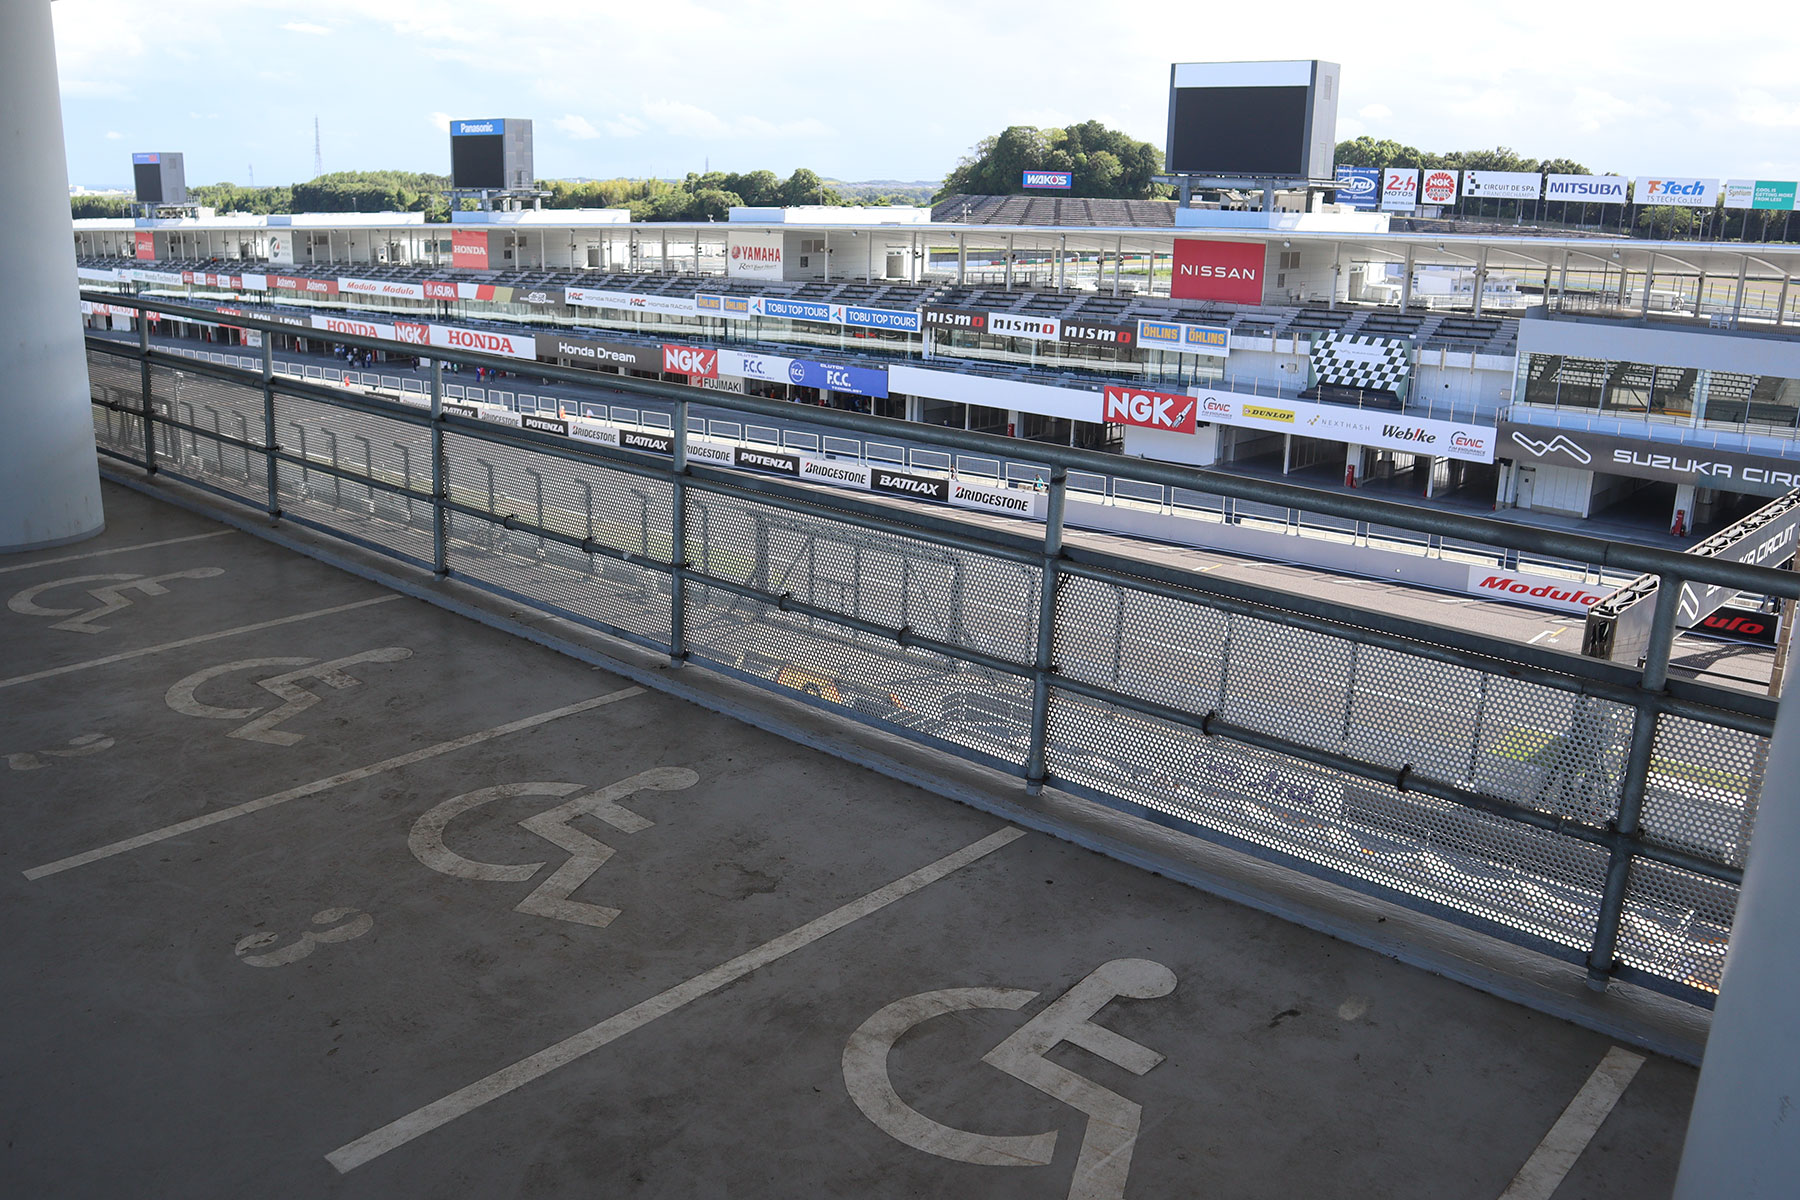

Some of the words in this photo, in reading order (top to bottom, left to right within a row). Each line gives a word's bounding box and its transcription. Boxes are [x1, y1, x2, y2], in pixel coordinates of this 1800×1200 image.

[461, 122, 494, 133] Panasonic
[1430, 179, 1450, 187] NGK
[1550, 182, 1622, 196] MITSUBA
[454, 246, 486, 255] HONDA
[742, 246, 781, 262] YAMAHA
[1181, 264, 1256, 280] NISSAN
[347, 282, 376, 292] Modulo
[382, 285, 414, 295] Modulo
[433, 286, 456, 298] ASURA
[568, 292, 582, 300] HRC
[630, 298, 646, 308] HRC
[768, 302, 787, 313] TOBU
[788, 305, 803, 315] TOP
[804, 307, 828, 318] TOURS
[849, 311, 870, 322] TOBU
[872, 314, 888, 324] TOP
[889, 316, 916, 327] TOURS
[326, 320, 378, 338] HONDA
[396, 324, 421, 344] NGK
[1143, 324, 1178, 340] ÖHLINS
[1188, 328, 1224, 344] ÖHLINS
[448, 330, 514, 353] HONDA
[558, 342, 595, 357] Honda
[597, 347, 636, 363] Dream
[666, 348, 705, 374] NGK
[744, 360, 765, 374] F.C.C.
[704, 378, 742, 392] FUJIMAKI
[827, 370, 852, 386] F.C.C.
[1108, 391, 1174, 428] NGK
[1208, 403, 1230, 412] EWC
[1252, 410, 1294, 420] DUNLOP
[526, 418, 564, 433] POTENZA
[1322, 419, 1370, 431] NEXTHASH
[572, 426, 616, 442] BRIDGESTONE
[626, 434, 668, 450] BATTLAX
[1456, 437, 1484, 448] EWC
[686, 445, 730, 462] RIDGESTONE
[740, 452, 794, 471] POTENZA
[1613, 449, 1732, 478] SUZUKA
[805, 462, 866, 484] BRIDGESTONE
[880, 475, 939, 496] BATTLAX
[955, 487, 1028, 512] BRIDGESTONE
[1757, 523, 1796, 564] CIRCUIT
[1479, 576, 1602, 606] Modulo
[1704, 616, 1764, 634] ulo
[235, 907, 374, 968] 3
